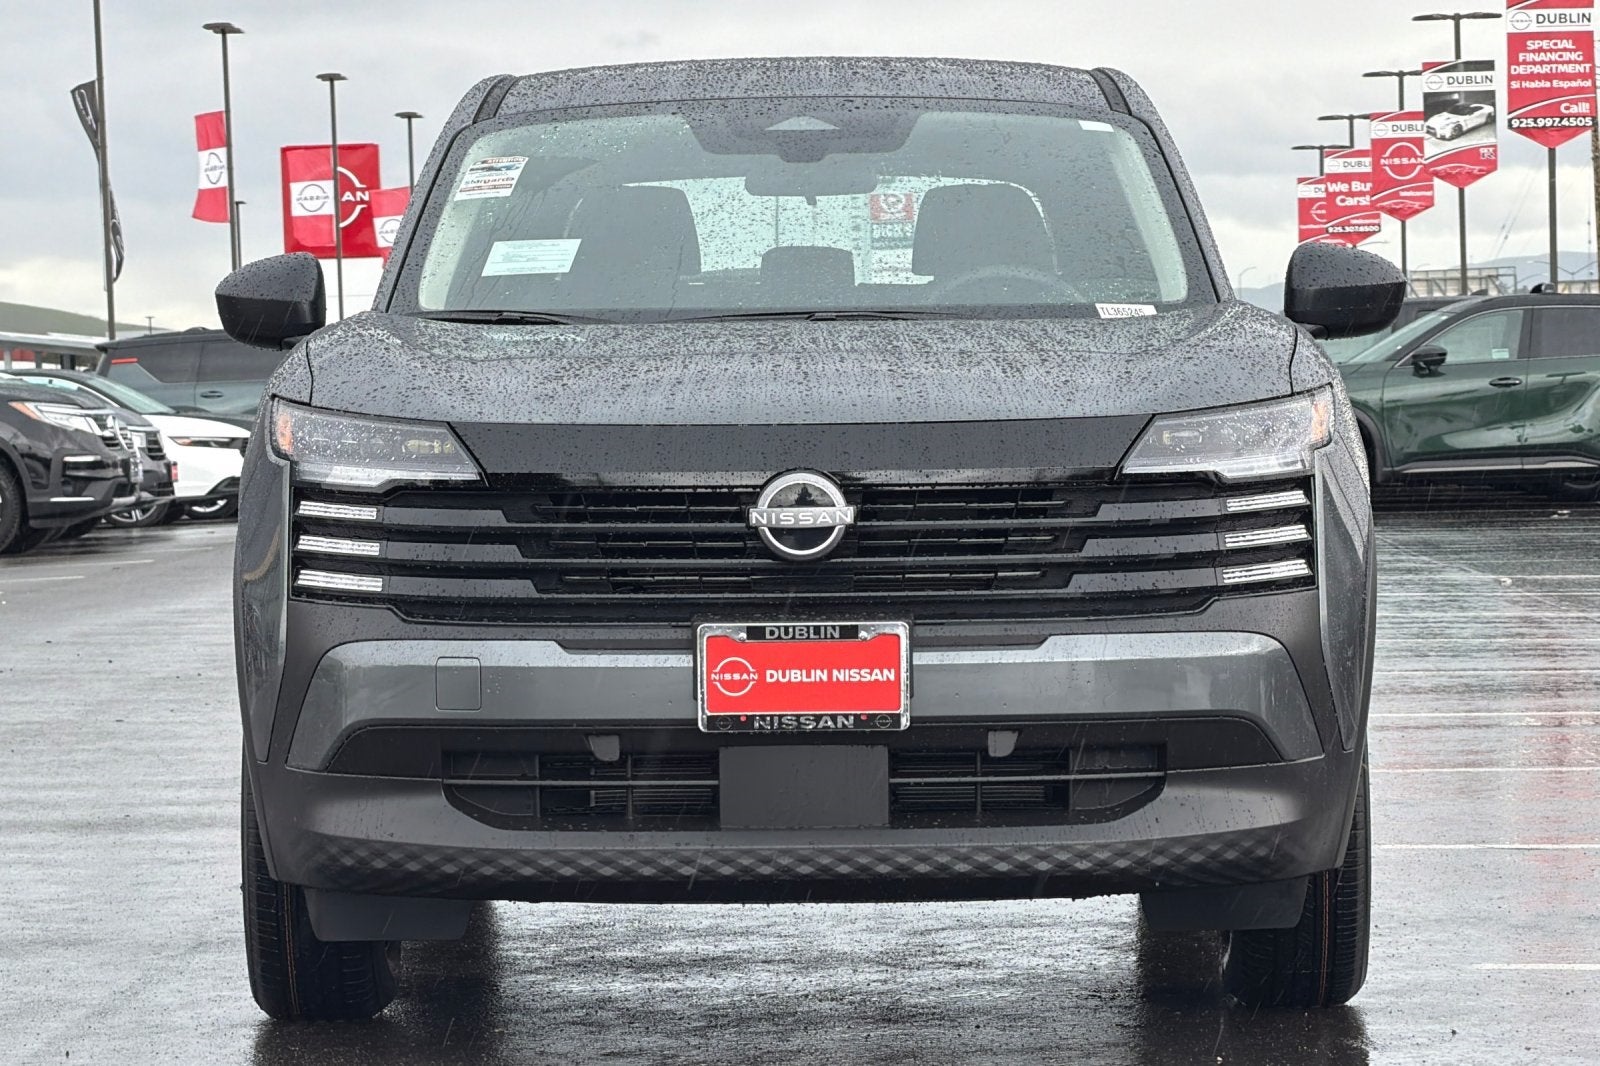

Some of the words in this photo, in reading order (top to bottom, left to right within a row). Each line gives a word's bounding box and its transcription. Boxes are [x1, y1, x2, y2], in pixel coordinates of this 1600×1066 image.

[1536, 13, 1591, 24] DUBLIN
[1526, 39, 1576, 50] SPECIAL
[1518, 51, 1584, 62] FINANCING
[1510, 64, 1592, 75] DEPARTMENT
[1446, 74, 1494, 85] DUBLIN
[1521, 79, 1551, 88] Habla
[1552, 79, 1592, 89] Español
[1560, 102, 1591, 114] Call!
[1391, 124, 1424, 132] DUBLI
[1511, 117, 1593, 128] 925.997.4505
[1326, 182, 1350, 192] We
[752, 510, 851, 525] NISSAN
[765, 625, 840, 639] DUBLIN
[711, 672, 758, 681] NISSAN
[766, 669, 828, 682] DUBLIN
[832, 668, 895, 682] NISSAN
[753, 715, 854, 730] NISSAN
